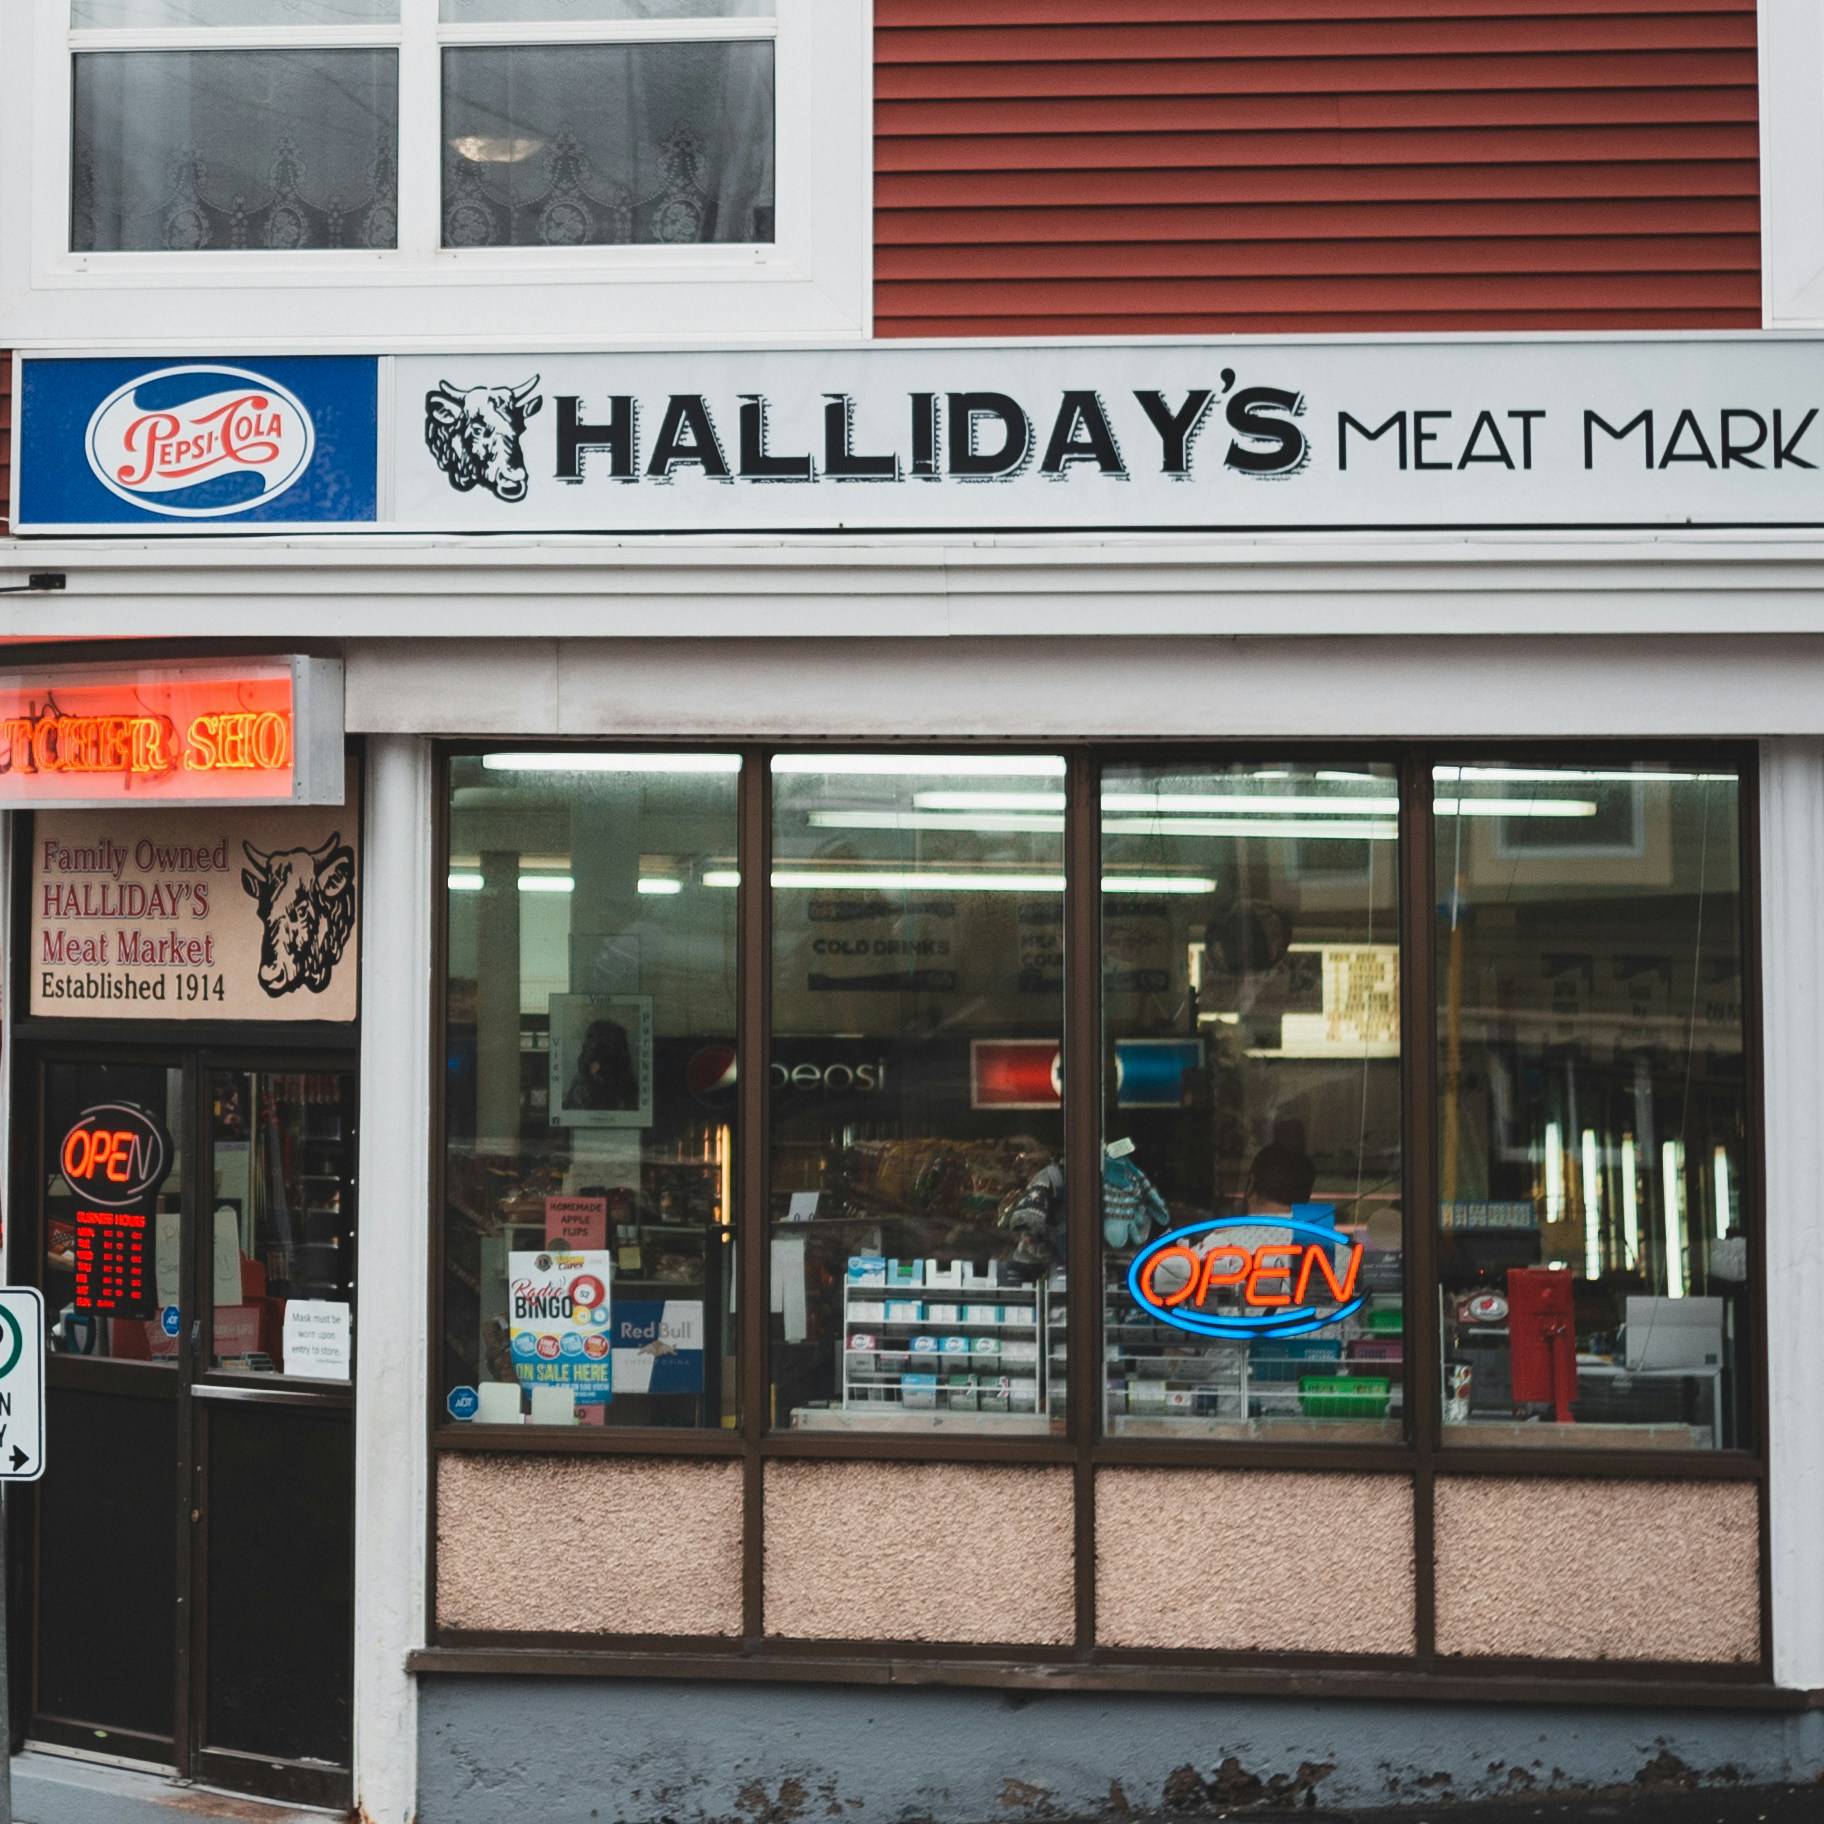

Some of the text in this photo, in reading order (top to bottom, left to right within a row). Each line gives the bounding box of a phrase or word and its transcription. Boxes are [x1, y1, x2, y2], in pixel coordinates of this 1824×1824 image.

[552, 367, 1314, 485] HALLIDAY'S
[1337, 408, 1547, 472] MEAT
[184, 712, 293, 772] SHO
[43, 838, 229, 880] Family Owned
[42, 881, 209, 919] HALLIDAY'S
[42, 929, 214, 966] Meat Market
[812, 939, 951, 956] COLD DRINKS
[1020, 935, 1064, 950] MEA
[1021, 953, 1064, 967] COU
[41, 972, 225, 1001] Established 1914
[64, 1129, 153, 1181] OPEN
[549, 1202, 603, 1212] HOMEMADE
[560, 1216, 591, 1225] APPLE
[562, 1228, 589, 1236] FLIPS
[1141, 1245, 1364, 1307] OPEN
[511, 1278, 567, 1306] Radio
[579, 1290, 590, 1300] 52
[514, 1296, 574, 1319] BINGO
[292, 1312, 341, 1325] Mask must be
[297, 1331, 336, 1342] worn upon
[621, 1321, 691, 1338] Red Bull
[291, 1346, 310, 1356] entry
[311, 1346, 320, 1355] to
[516, 1363, 609, 1382] ON SALE HERE
[455, 1397, 473, 1407] ADT
